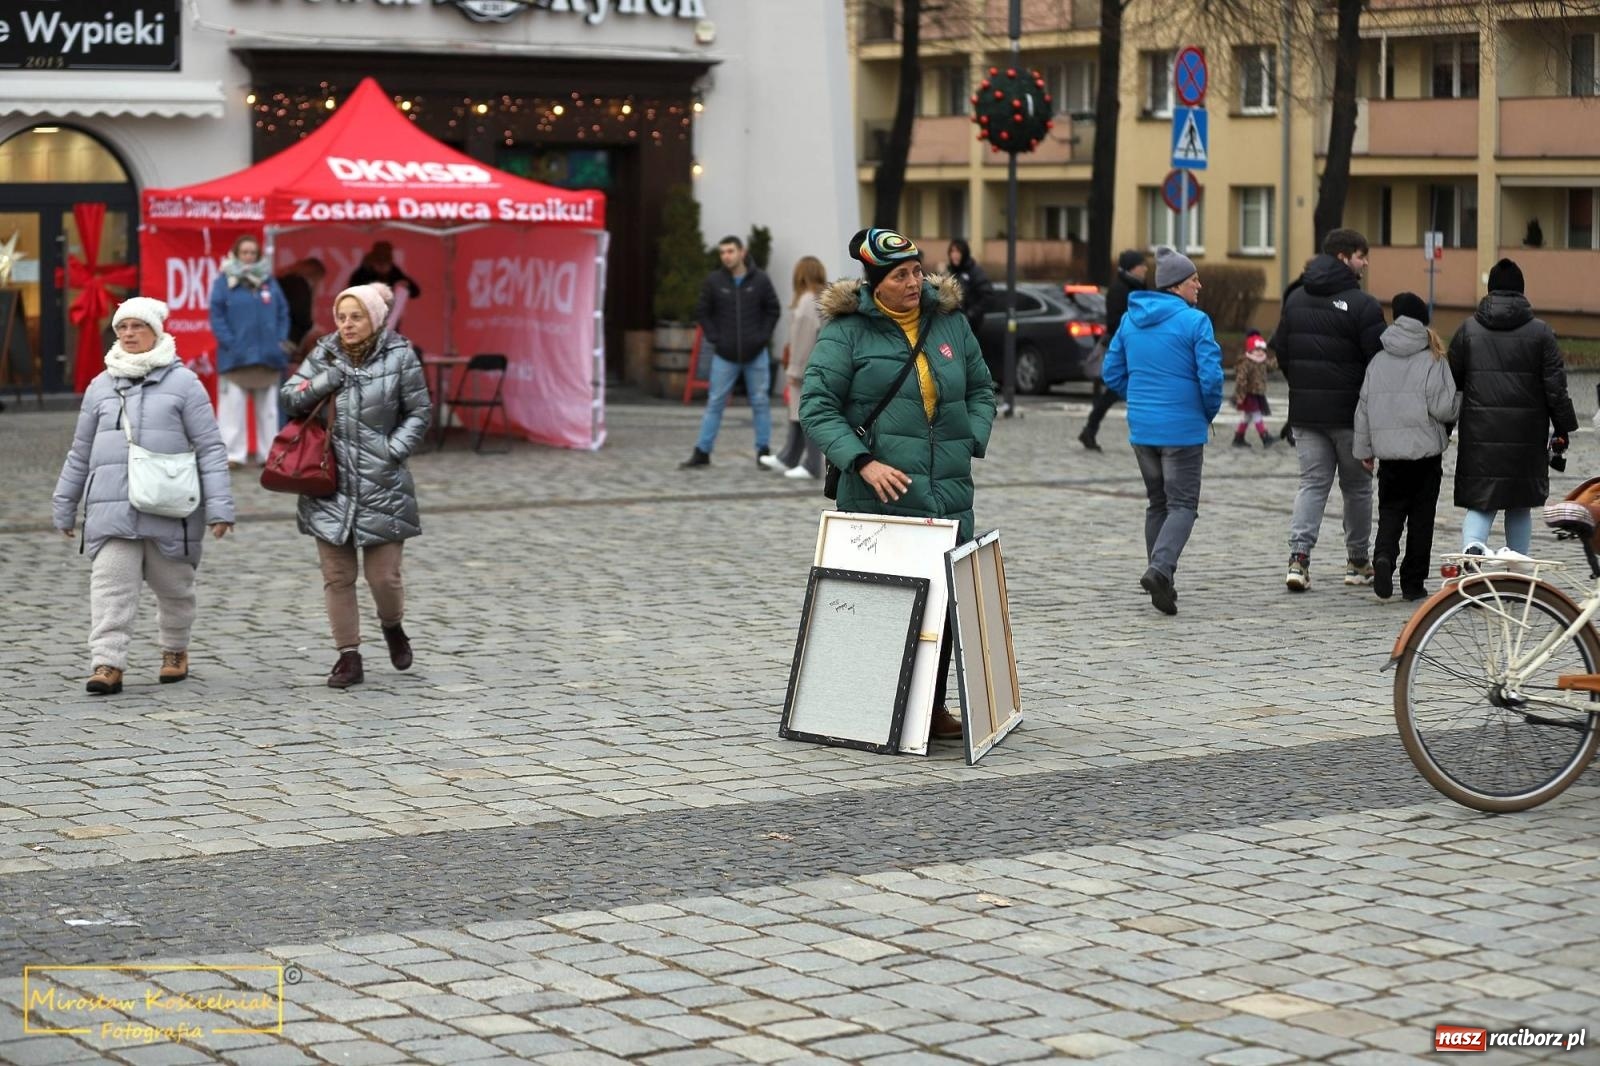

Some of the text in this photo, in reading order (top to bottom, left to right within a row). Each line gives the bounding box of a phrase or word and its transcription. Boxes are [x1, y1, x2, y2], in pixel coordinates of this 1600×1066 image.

[19, 9, 165, 53] Wypieki
[326, 156, 456, 183] DKMS
[292, 196, 391, 221] Zostań
[497, 197, 595, 222] Szpiku!
